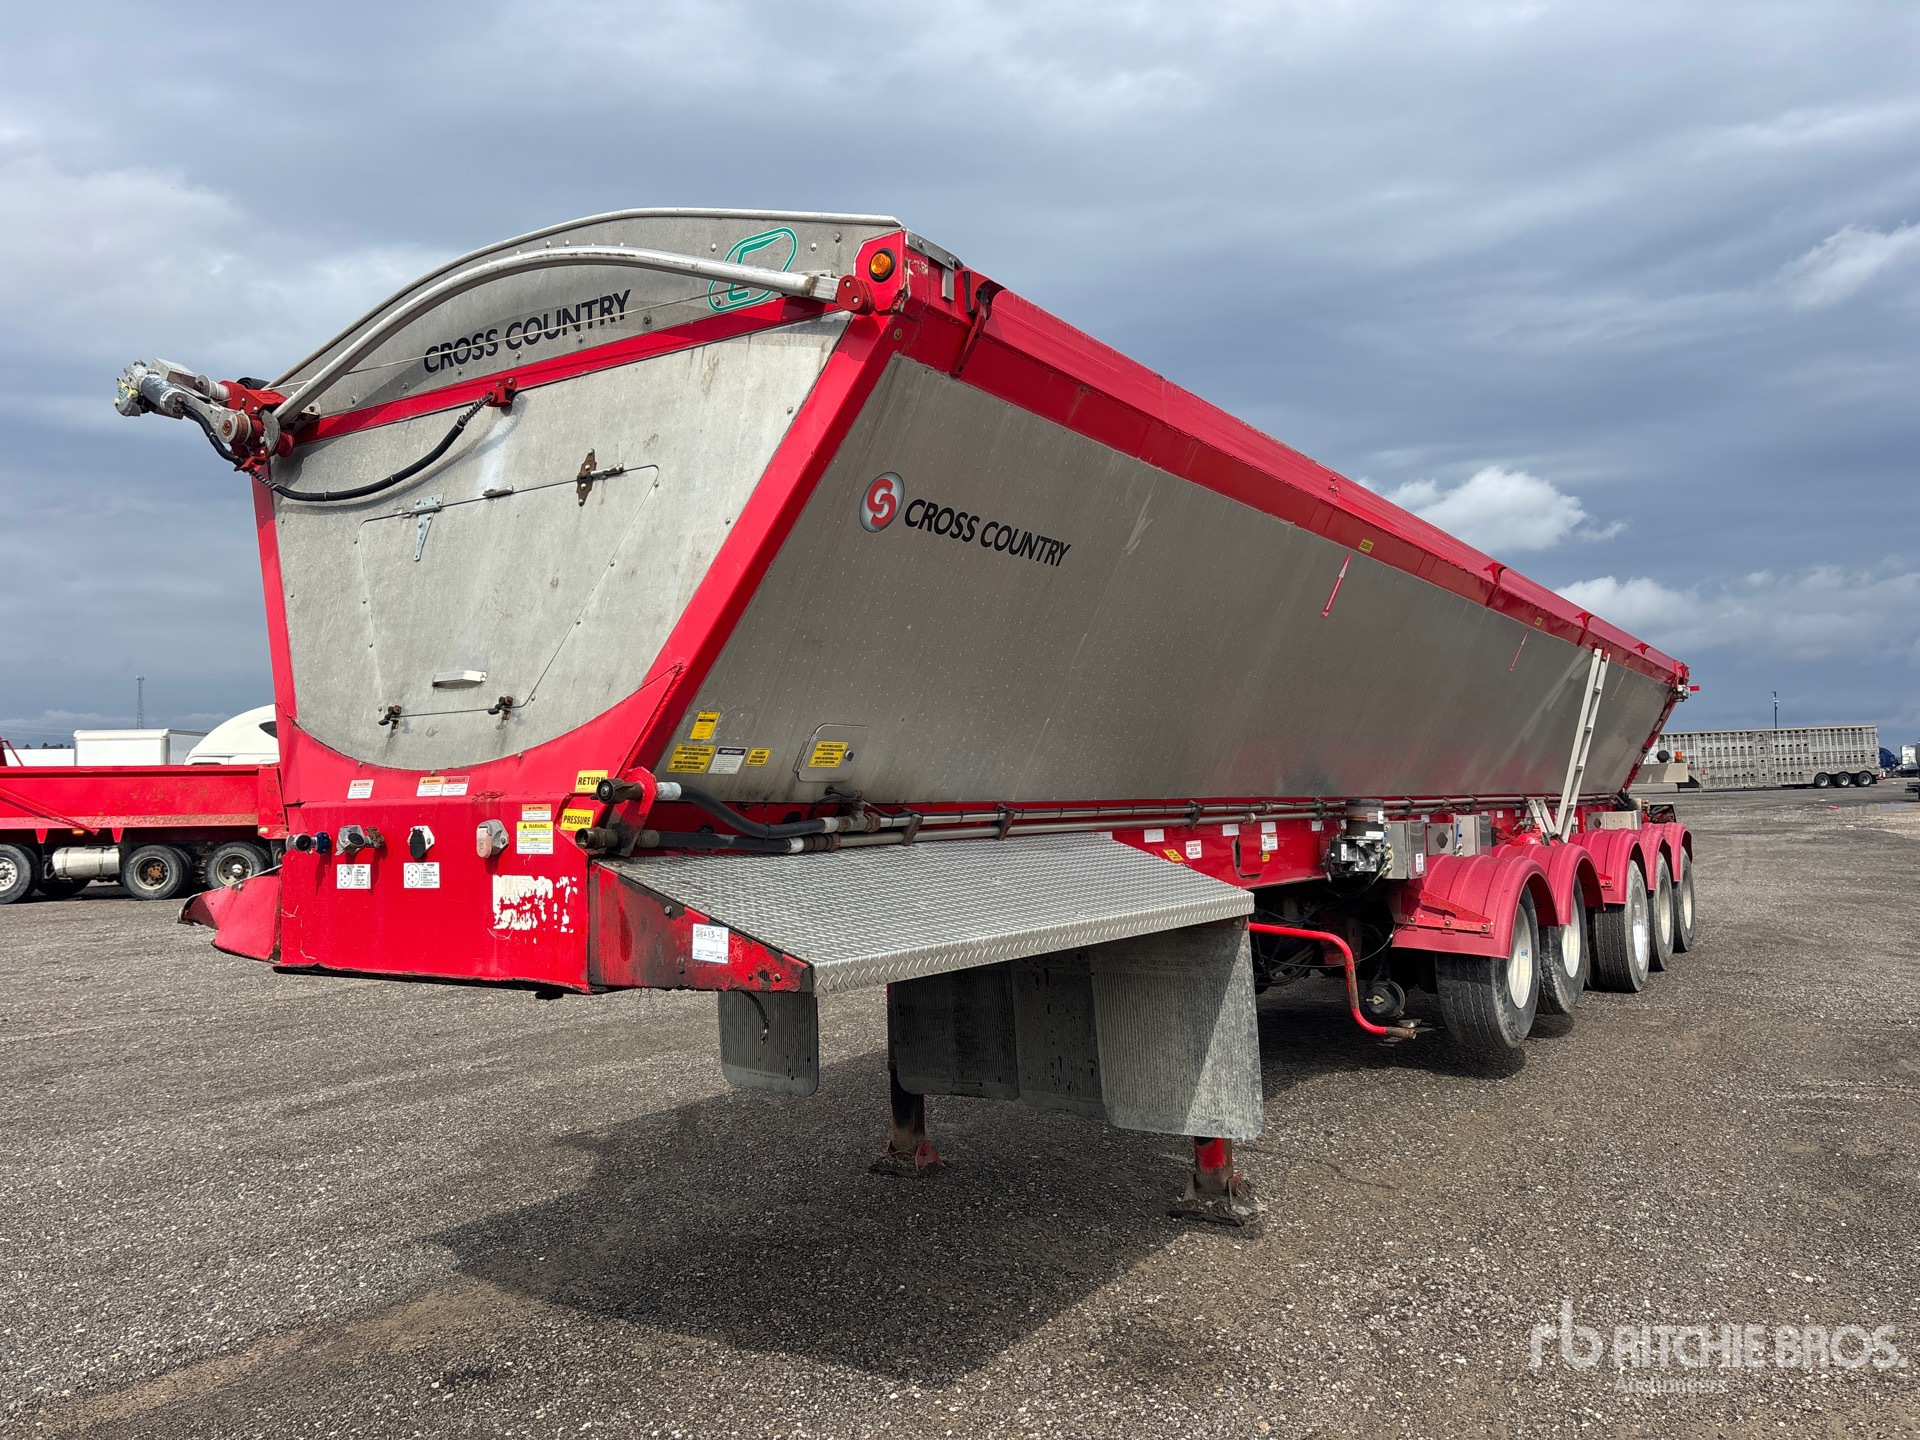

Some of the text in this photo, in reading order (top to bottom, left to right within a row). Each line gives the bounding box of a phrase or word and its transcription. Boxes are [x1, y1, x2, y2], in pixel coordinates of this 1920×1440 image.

[424, 289, 632, 374] CROSS COUNTRY
[904, 498, 1072, 567] CROSS COUNTRY
[563, 815, 591, 825] PRESSURE
